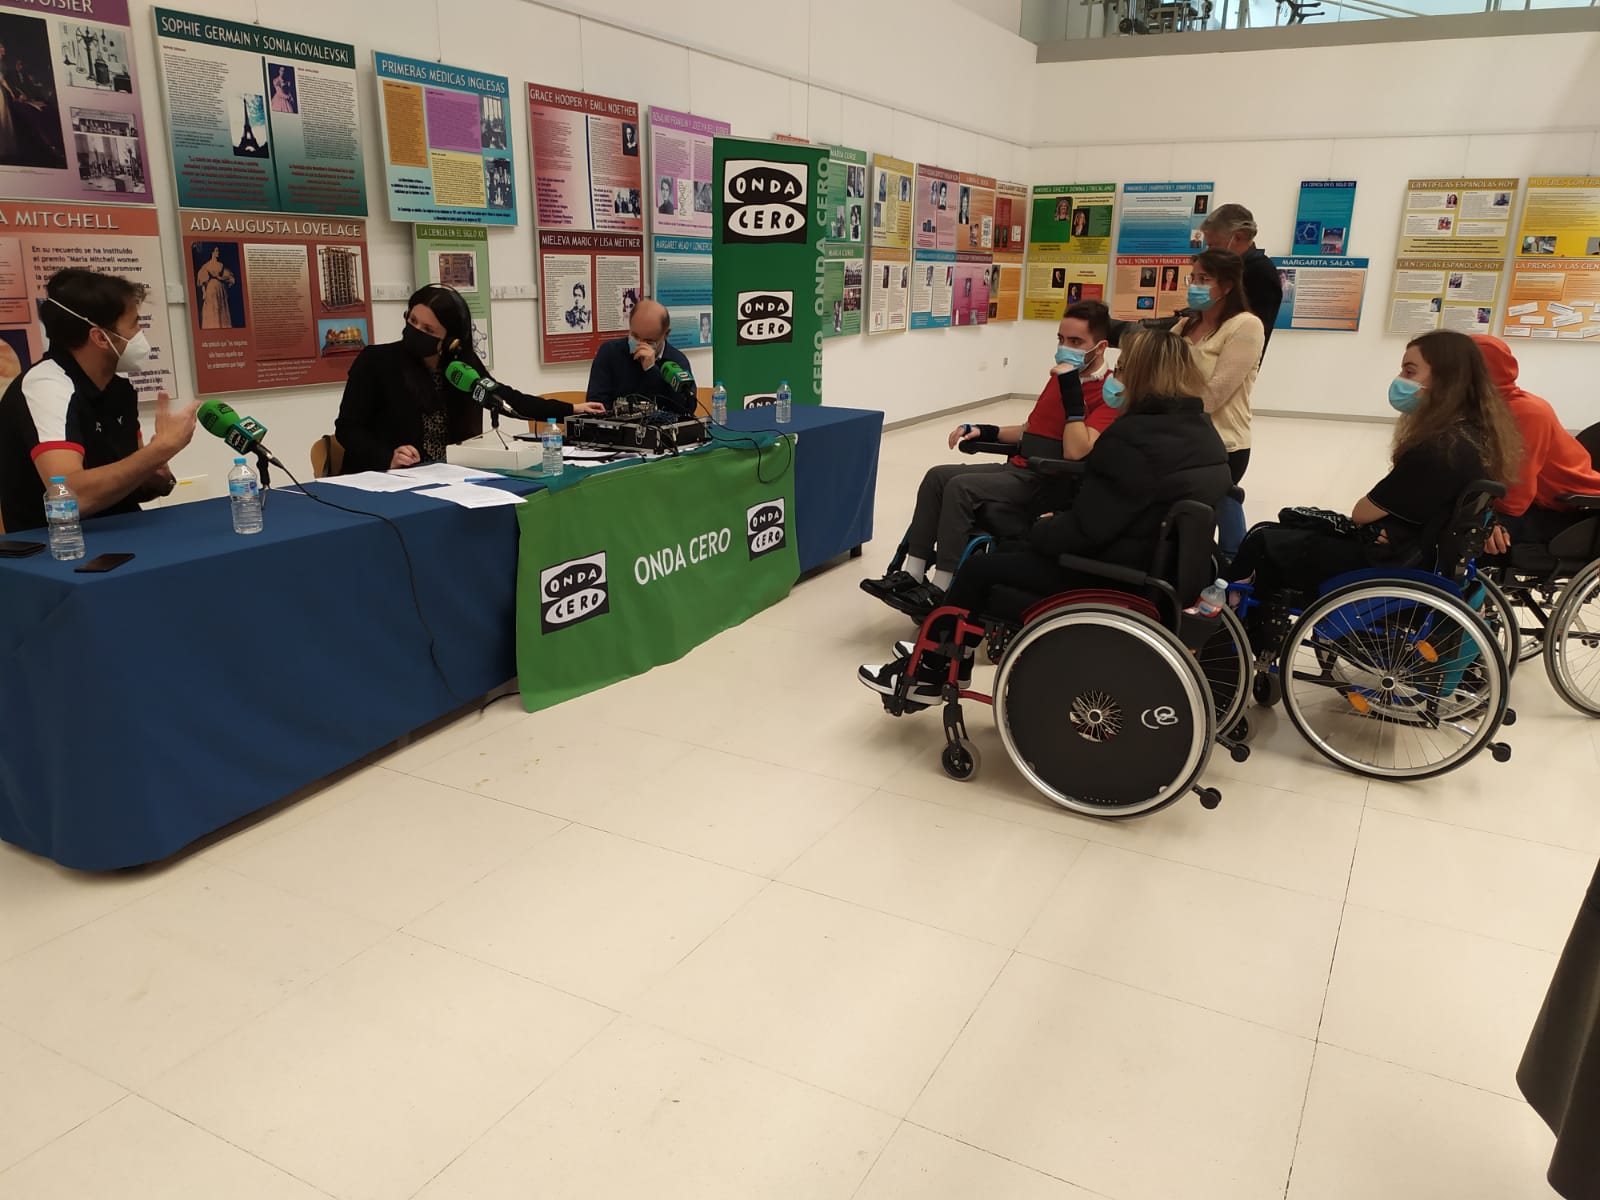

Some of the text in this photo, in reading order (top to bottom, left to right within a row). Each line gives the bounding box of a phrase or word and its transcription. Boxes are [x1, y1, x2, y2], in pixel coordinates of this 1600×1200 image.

[161, 16, 349, 63] SOPHIE GERMAIN Y SONIA KOVALEVSKI
[382, 59, 427, 79] PRIMERAS
[468, 76, 506, 94] INGLESAS
[529, 88, 553, 103] GRACE
[555, 94, 582, 107] HOOPER
[583, 99, 588, 107] Y
[608, 103, 637, 118] NOETHER
[736, 176, 796, 230] ONDA CERO
[15, 210, 119, 231] MITCHELL
[190, 217, 361, 238] ADA AUGUSTA LOVELACE
[428, 228, 448, 237] CIENCIA
[52, 246, 82, 254] recuerdo
[103, 247, 133, 255] instituido
[541, 235, 571, 246] MIELEVA
[593, 237, 598, 247] Y
[599, 237, 613, 247] LISA
[614, 237, 641, 249] MEITNER
[813, 156, 831, 395] CERO ONDA CERO
[1281, 258, 1355, 267] MARGARITA SALAS
[744, 302, 786, 336] ONDA CERO
[752, 510, 781, 550] ONDA CERO
[634, 527, 732, 586] ONDA CERO
[550, 567, 599, 619] ONDA CERO
